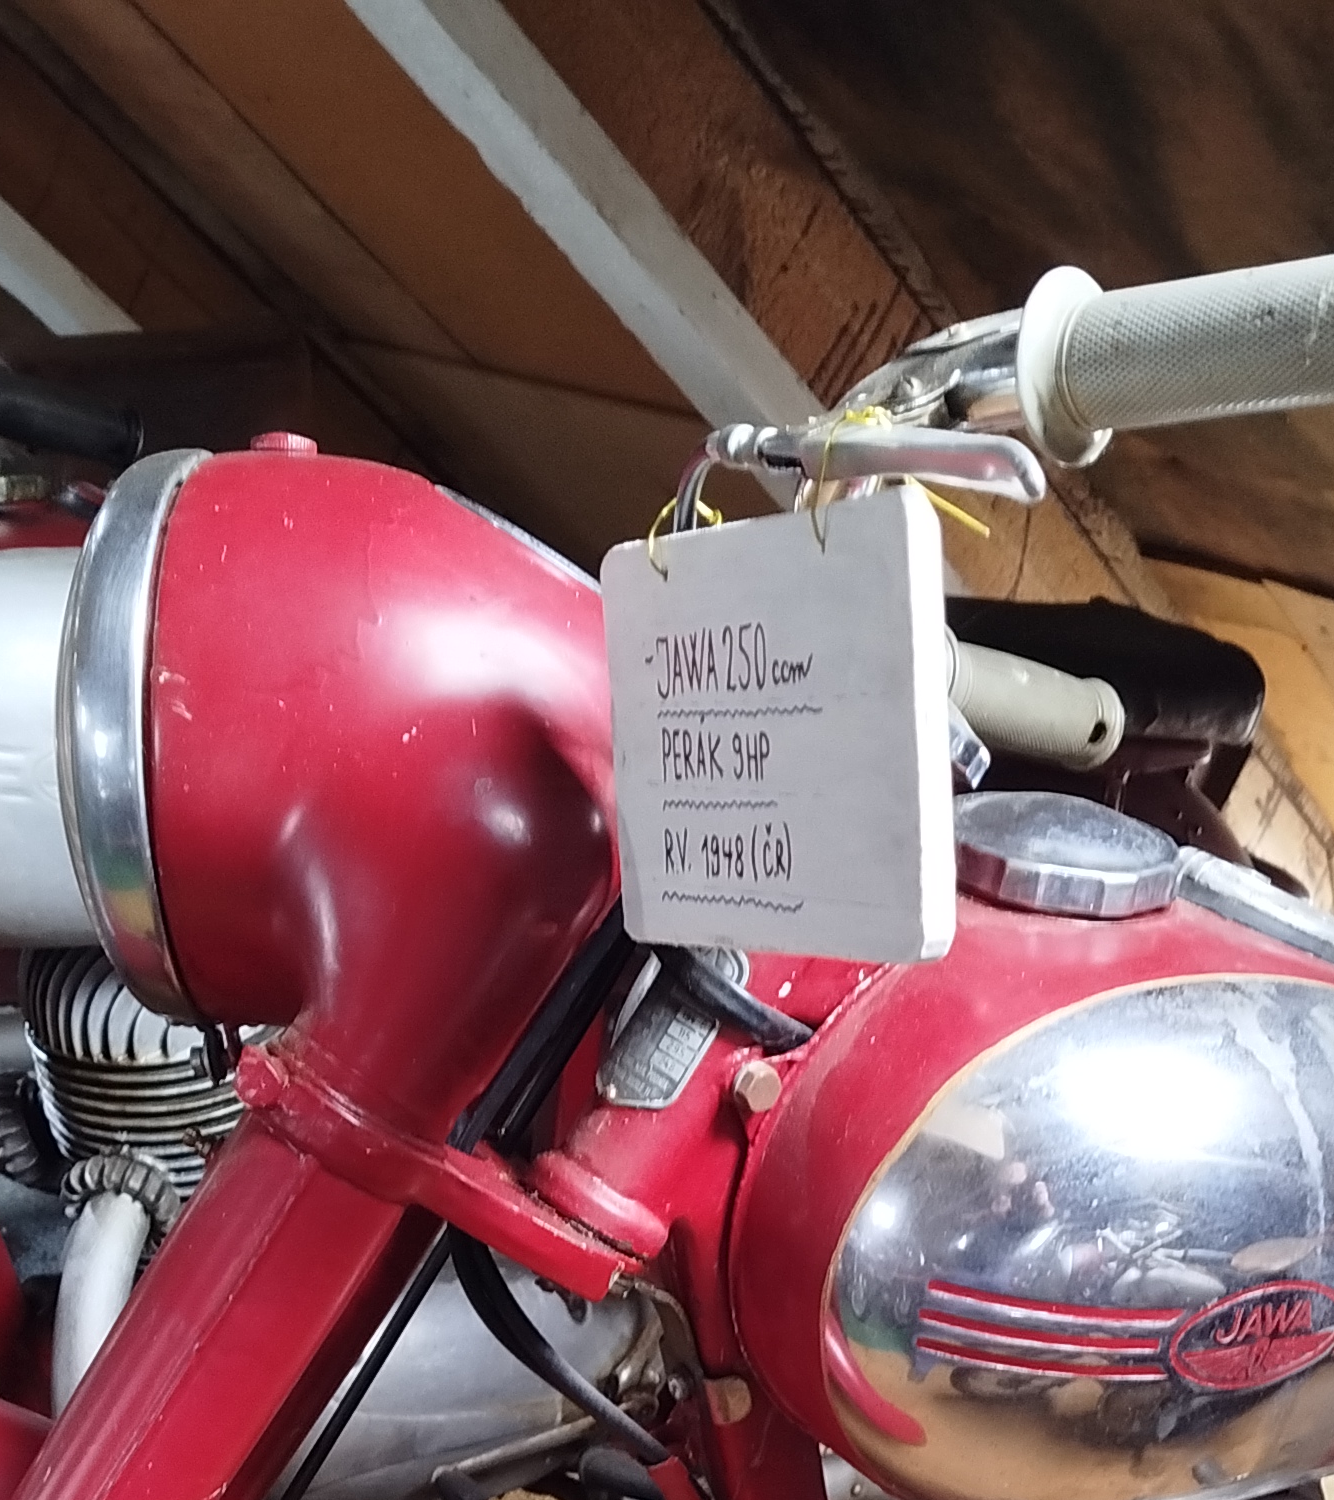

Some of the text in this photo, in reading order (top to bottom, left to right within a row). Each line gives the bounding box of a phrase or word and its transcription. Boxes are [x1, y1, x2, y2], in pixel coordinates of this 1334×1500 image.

[722, 621, 767, 692] 250
[771, 652, 814, 687] ccm
[662, 715, 771, 783] PERÁK 9HP
[701, 833, 745, 879] 1948
[1215, 1298, 1313, 1345] JAWA
